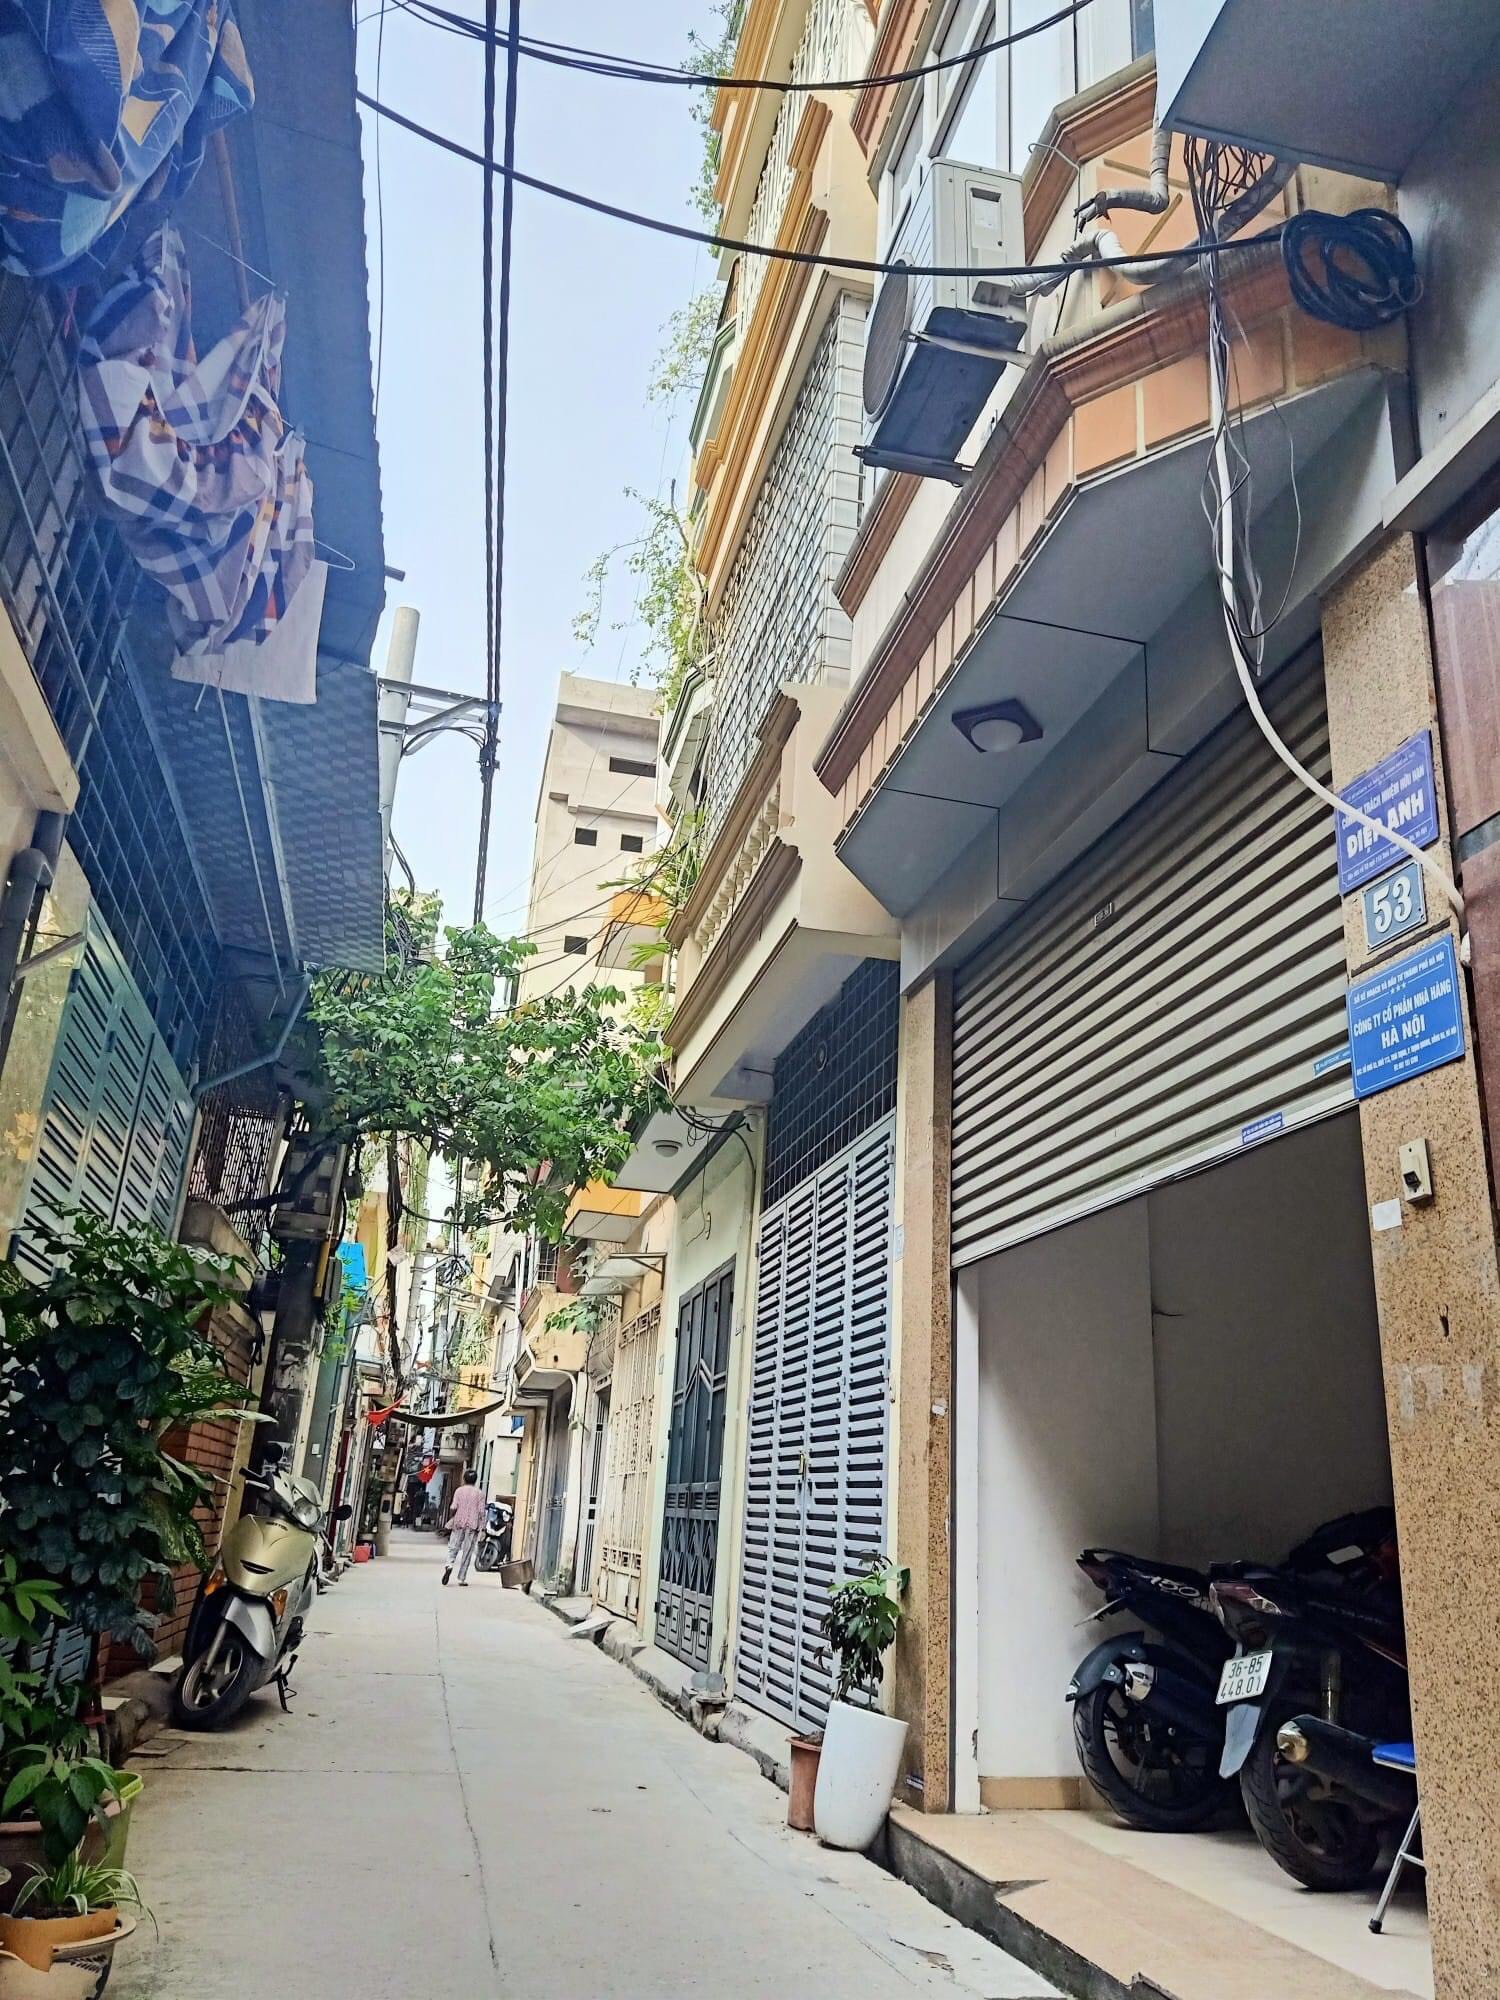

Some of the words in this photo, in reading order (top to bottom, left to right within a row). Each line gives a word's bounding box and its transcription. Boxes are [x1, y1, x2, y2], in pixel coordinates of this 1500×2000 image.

[1387, 788, 1425, 831] ANH
[1373, 875, 1413, 933] 53
[1353, 1017, 1373, 1037] CÔNG
[1373, 1013, 1381, 1028] TY
[1382, 1001, 1393, 1023] CỔ
[1393, 995, 1413, 1019] PHẦN
[1413, 986, 1430, 1008] NHÀ
[1430, 979, 1452, 1001] HÀNG
[1381, 1024, 1400, 1049] HÀ
[1401, 1014, 1426, 1040] NỘI
[1219, 1676, 1262, 1700] 448.01
